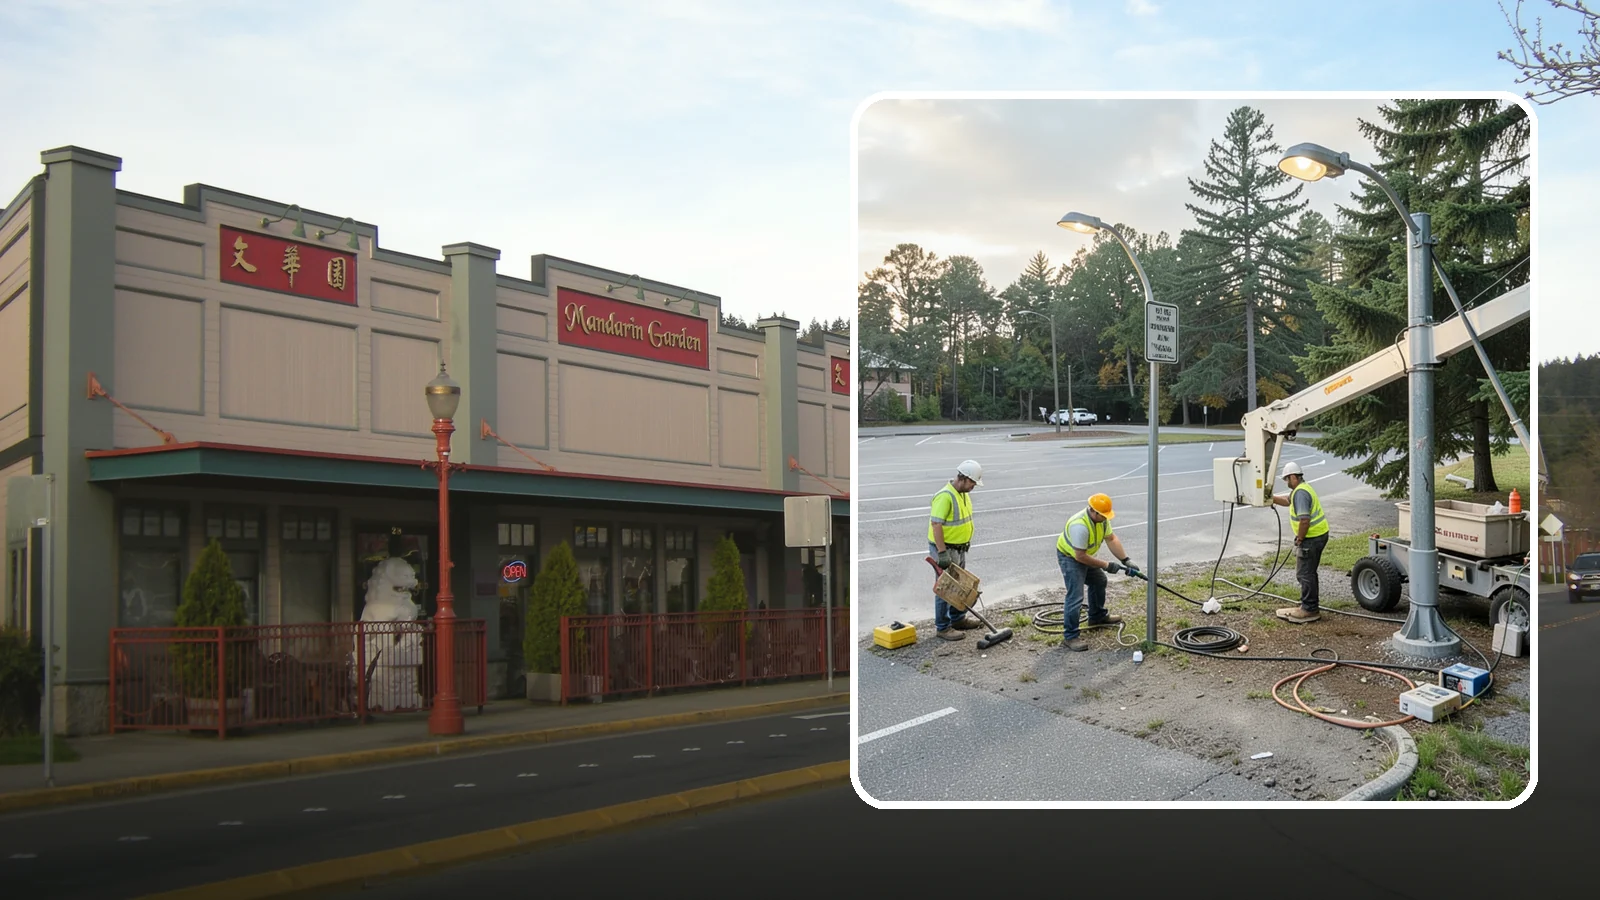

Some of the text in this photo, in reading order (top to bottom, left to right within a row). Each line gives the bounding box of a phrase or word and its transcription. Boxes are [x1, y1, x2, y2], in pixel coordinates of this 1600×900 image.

[231, 235, 346, 291] 文華園
[564, 302, 701, 352] Mandarin Garden
[834, 363, 847, 386] 文
[503, 565, 527, 578] OPEN
